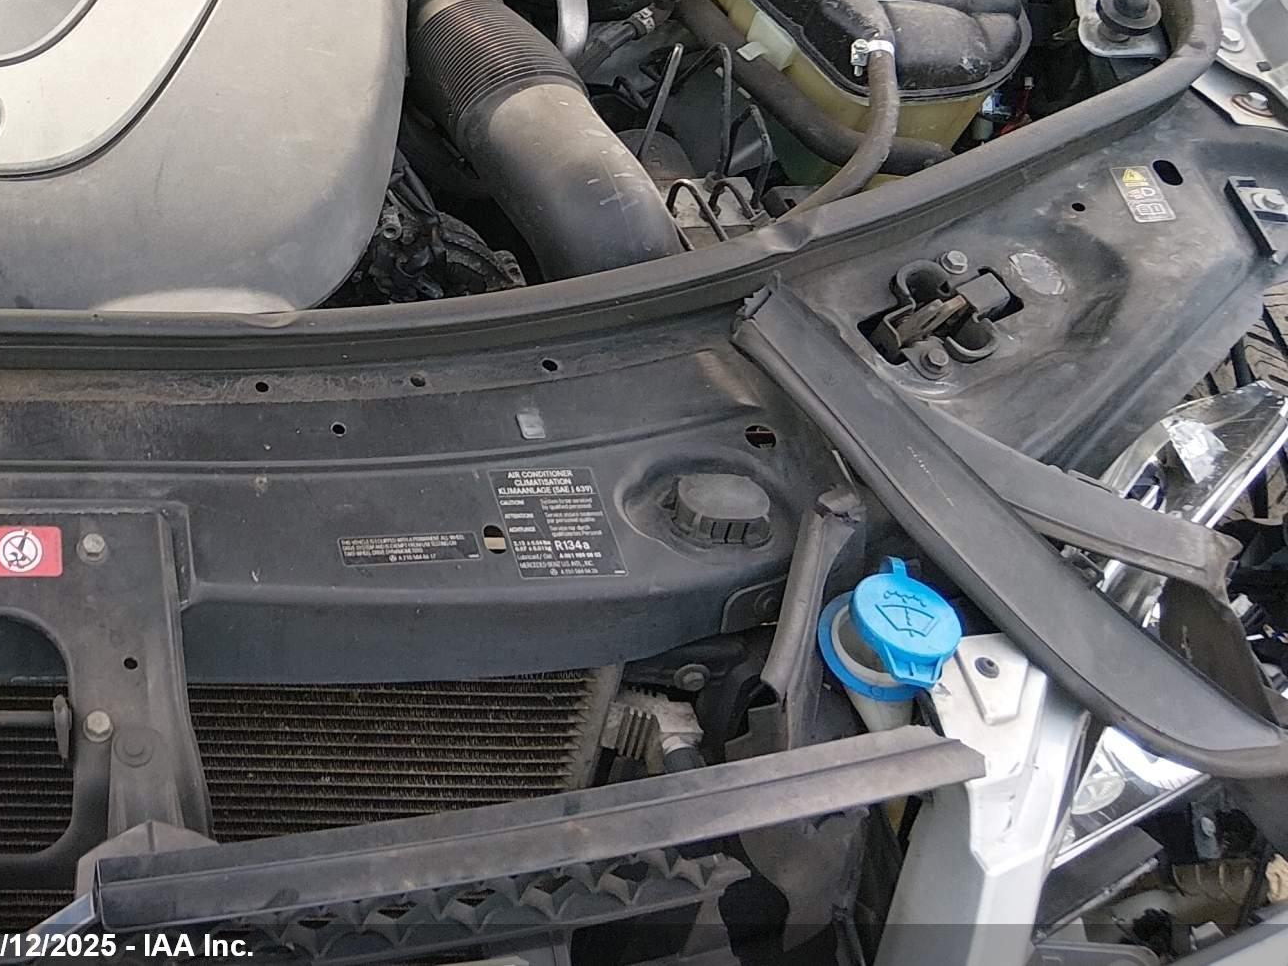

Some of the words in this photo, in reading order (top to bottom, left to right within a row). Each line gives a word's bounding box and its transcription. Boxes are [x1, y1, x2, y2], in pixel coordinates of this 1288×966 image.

[508, 471, 520, 479] AIR
[521, 469, 573, 478] CONDITIONER
[554, 539, 590, 550] R134a
